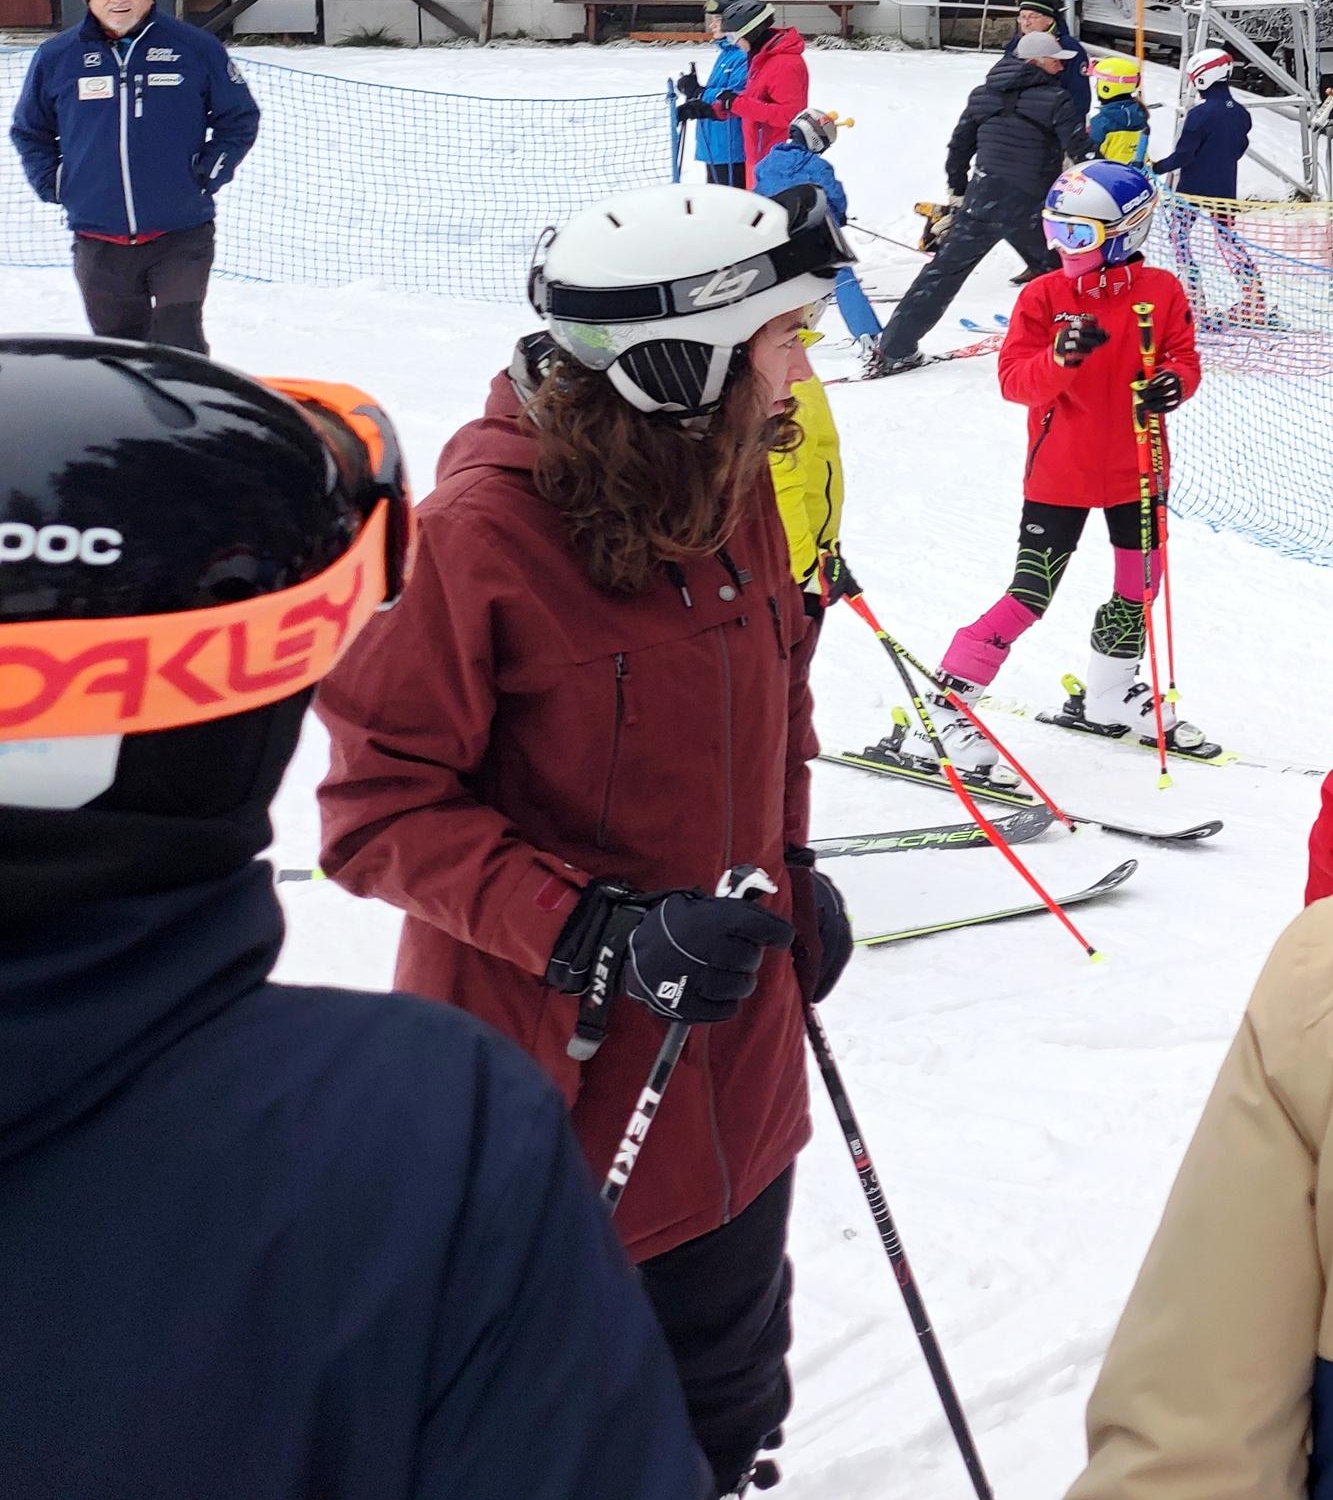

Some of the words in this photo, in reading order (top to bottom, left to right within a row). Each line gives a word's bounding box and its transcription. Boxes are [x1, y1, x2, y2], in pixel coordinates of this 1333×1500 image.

[0, 561, 364, 729] OAKLEY
[591, 945, 615, 1006] LEKI
[607, 1086, 661, 1186] LEKI
